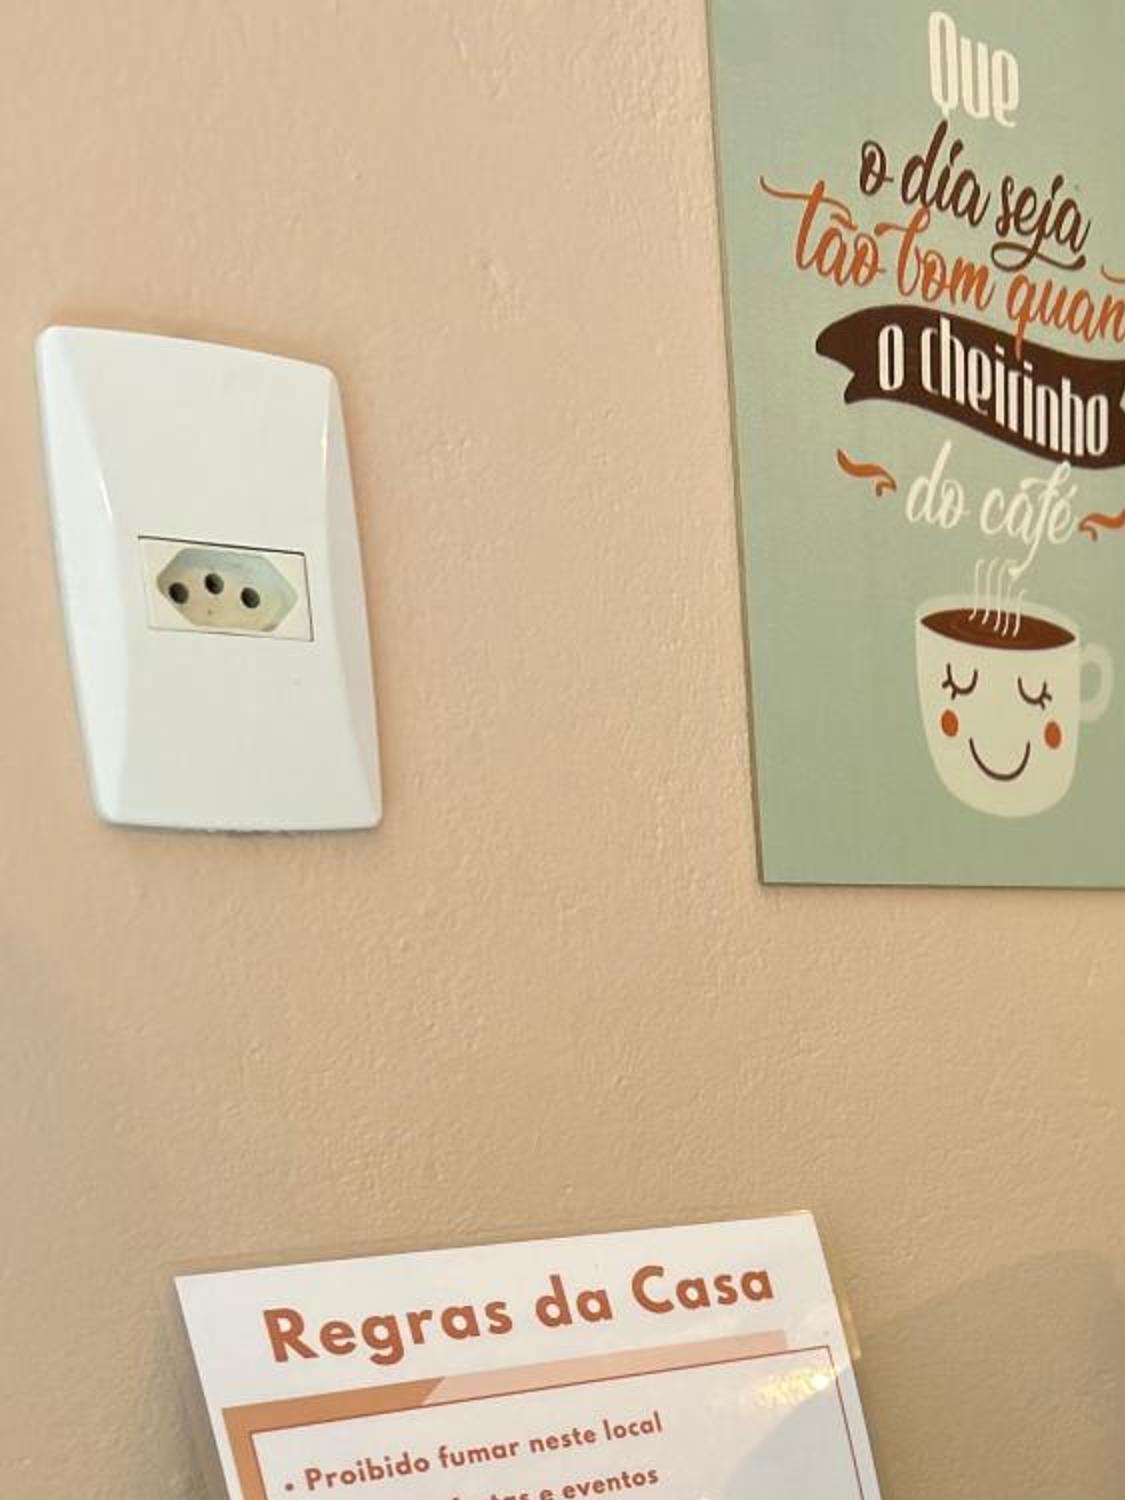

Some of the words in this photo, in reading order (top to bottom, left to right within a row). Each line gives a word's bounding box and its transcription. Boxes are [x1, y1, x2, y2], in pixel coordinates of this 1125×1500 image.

[928, 11, 1020, 128] Que
[759, 175, 887, 288] tão
[873, 207, 997, 311] bom
[859, 139, 894, 196] o
[900, 119, 991, 228] dia
[991, 174, 1091, 272] seja
[920, 315, 1110, 458] cheirinho
[905, 438, 970, 530] do
[980, 460, 1078, 578] café
[261, 1300, 514, 1367] Regras
[534, 1273, 614, 1329] da
[631, 1264, 775, 1315] Casa
[303, 1450, 431, 1492] Proibido
[437, 1440, 521, 1470] fumar
[528, 1427, 598, 1454] neste
[601, 1409, 664, 1441] local
[561, 1469, 660, 1500] eventos
